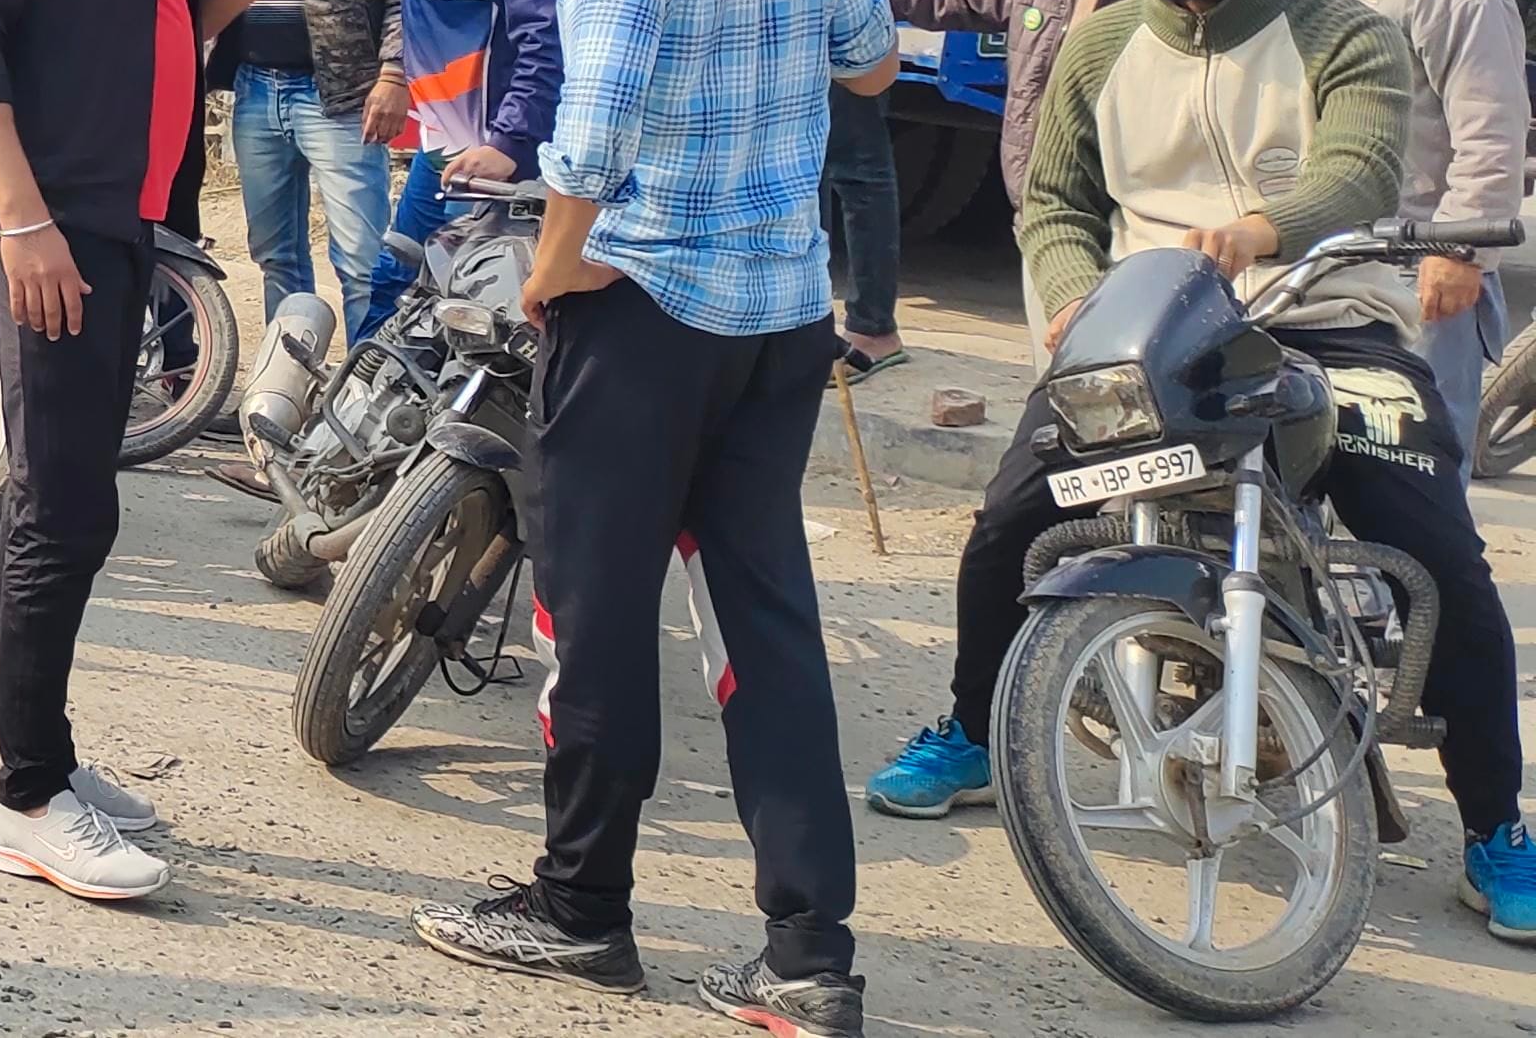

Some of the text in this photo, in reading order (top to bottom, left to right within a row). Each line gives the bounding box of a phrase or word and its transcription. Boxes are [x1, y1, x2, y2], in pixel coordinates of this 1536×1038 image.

[1057, 449, 1194, 502] HR 13P 6997
[1334, 432, 1435, 476] PUNISHER
